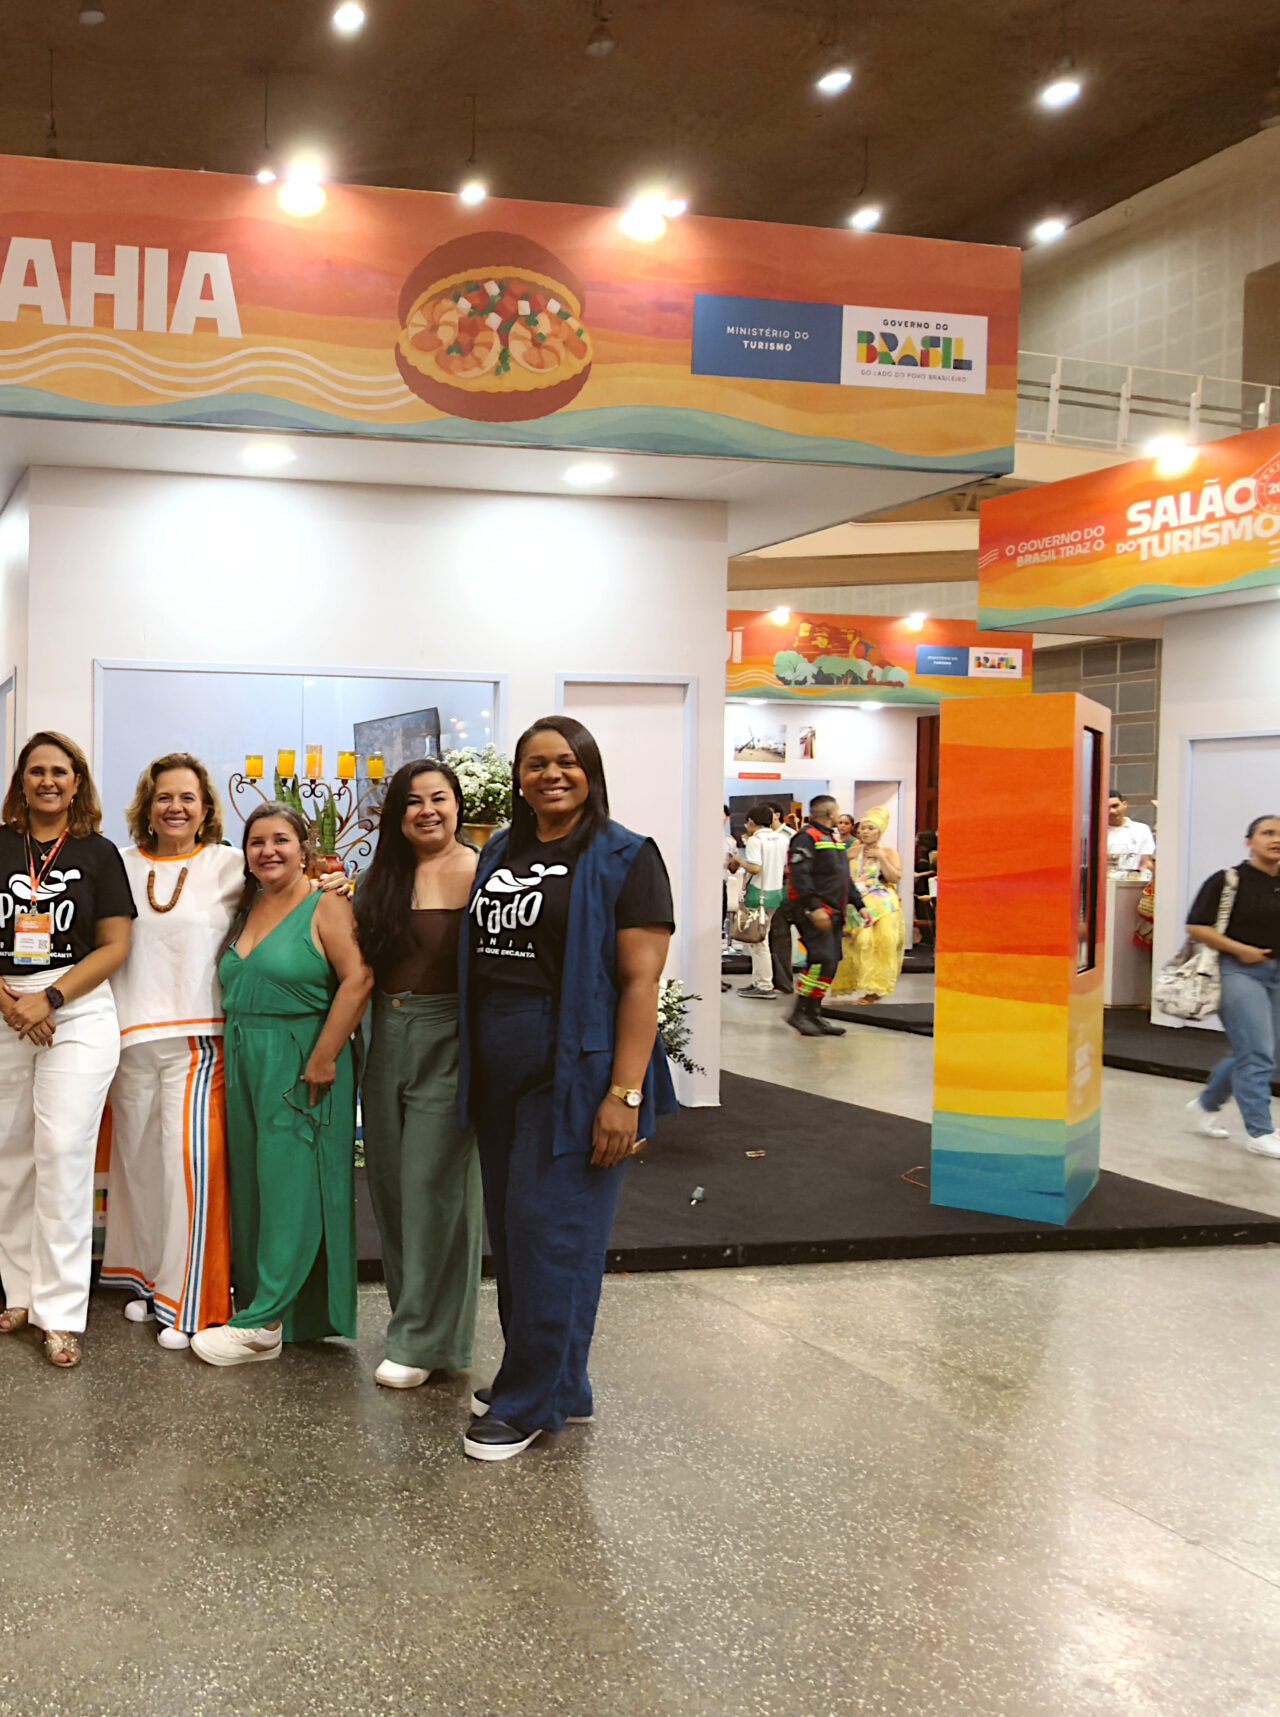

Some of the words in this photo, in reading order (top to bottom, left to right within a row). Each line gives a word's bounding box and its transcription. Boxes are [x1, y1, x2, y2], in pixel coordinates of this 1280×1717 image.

[726, 326, 790, 338] MINISTÉRIO
[794, 331, 810, 340] DO
[883, 319, 929, 329] GOVERNO
[743, 340, 792, 351] TURISMO
[856, 330, 972, 371] BRASIL
[1127, 477, 1258, 536] SALÃO
[1005, 545, 1015, 556] O
[1017, 530, 1082, 553] GOVERNO
[1084, 525, 1105, 540] DO
[1116, 541, 1136, 554] DO
[1136, 512, 1280, 561] TURISMO
[1016, 548, 1057, 567] BRASIL
[1058, 543, 1090, 561] TRAZ
[1092, 539, 1105, 551] O
